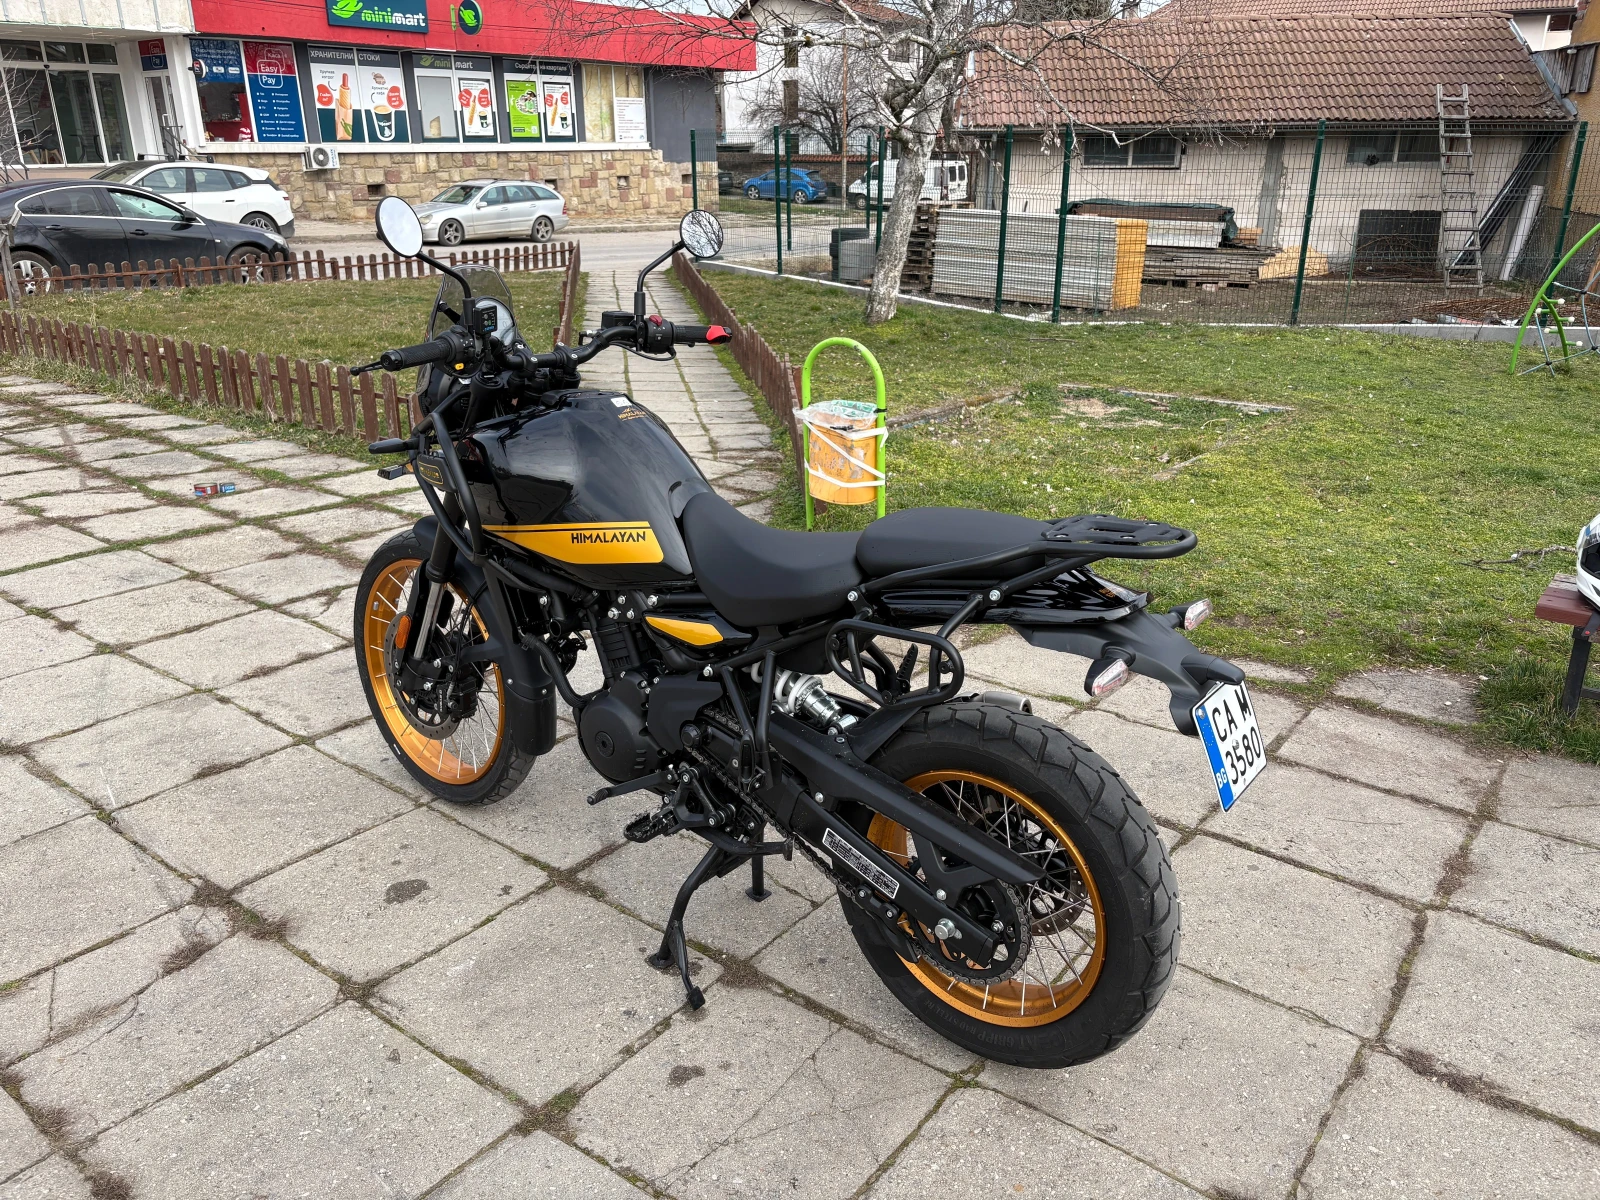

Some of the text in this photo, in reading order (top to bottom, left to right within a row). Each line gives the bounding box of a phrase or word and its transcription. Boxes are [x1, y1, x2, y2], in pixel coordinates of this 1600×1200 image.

[361, 6, 426, 27] minimart
[310, 50, 380, 61] ХРАНИТЕЛНИ СТОКИ
[260, 63, 278, 74] Easy
[434, 58, 474, 69] mini mart
[262, 75, 276, 85] Pay
[571, 531, 646, 544] HIMALAYAN
[1212, 684, 1252, 742] CA M
[1225, 726, 1262, 785] 3580
[1216, 767, 1227, 789] BG
[977, 1030, 1015, 1048] GRIPP
